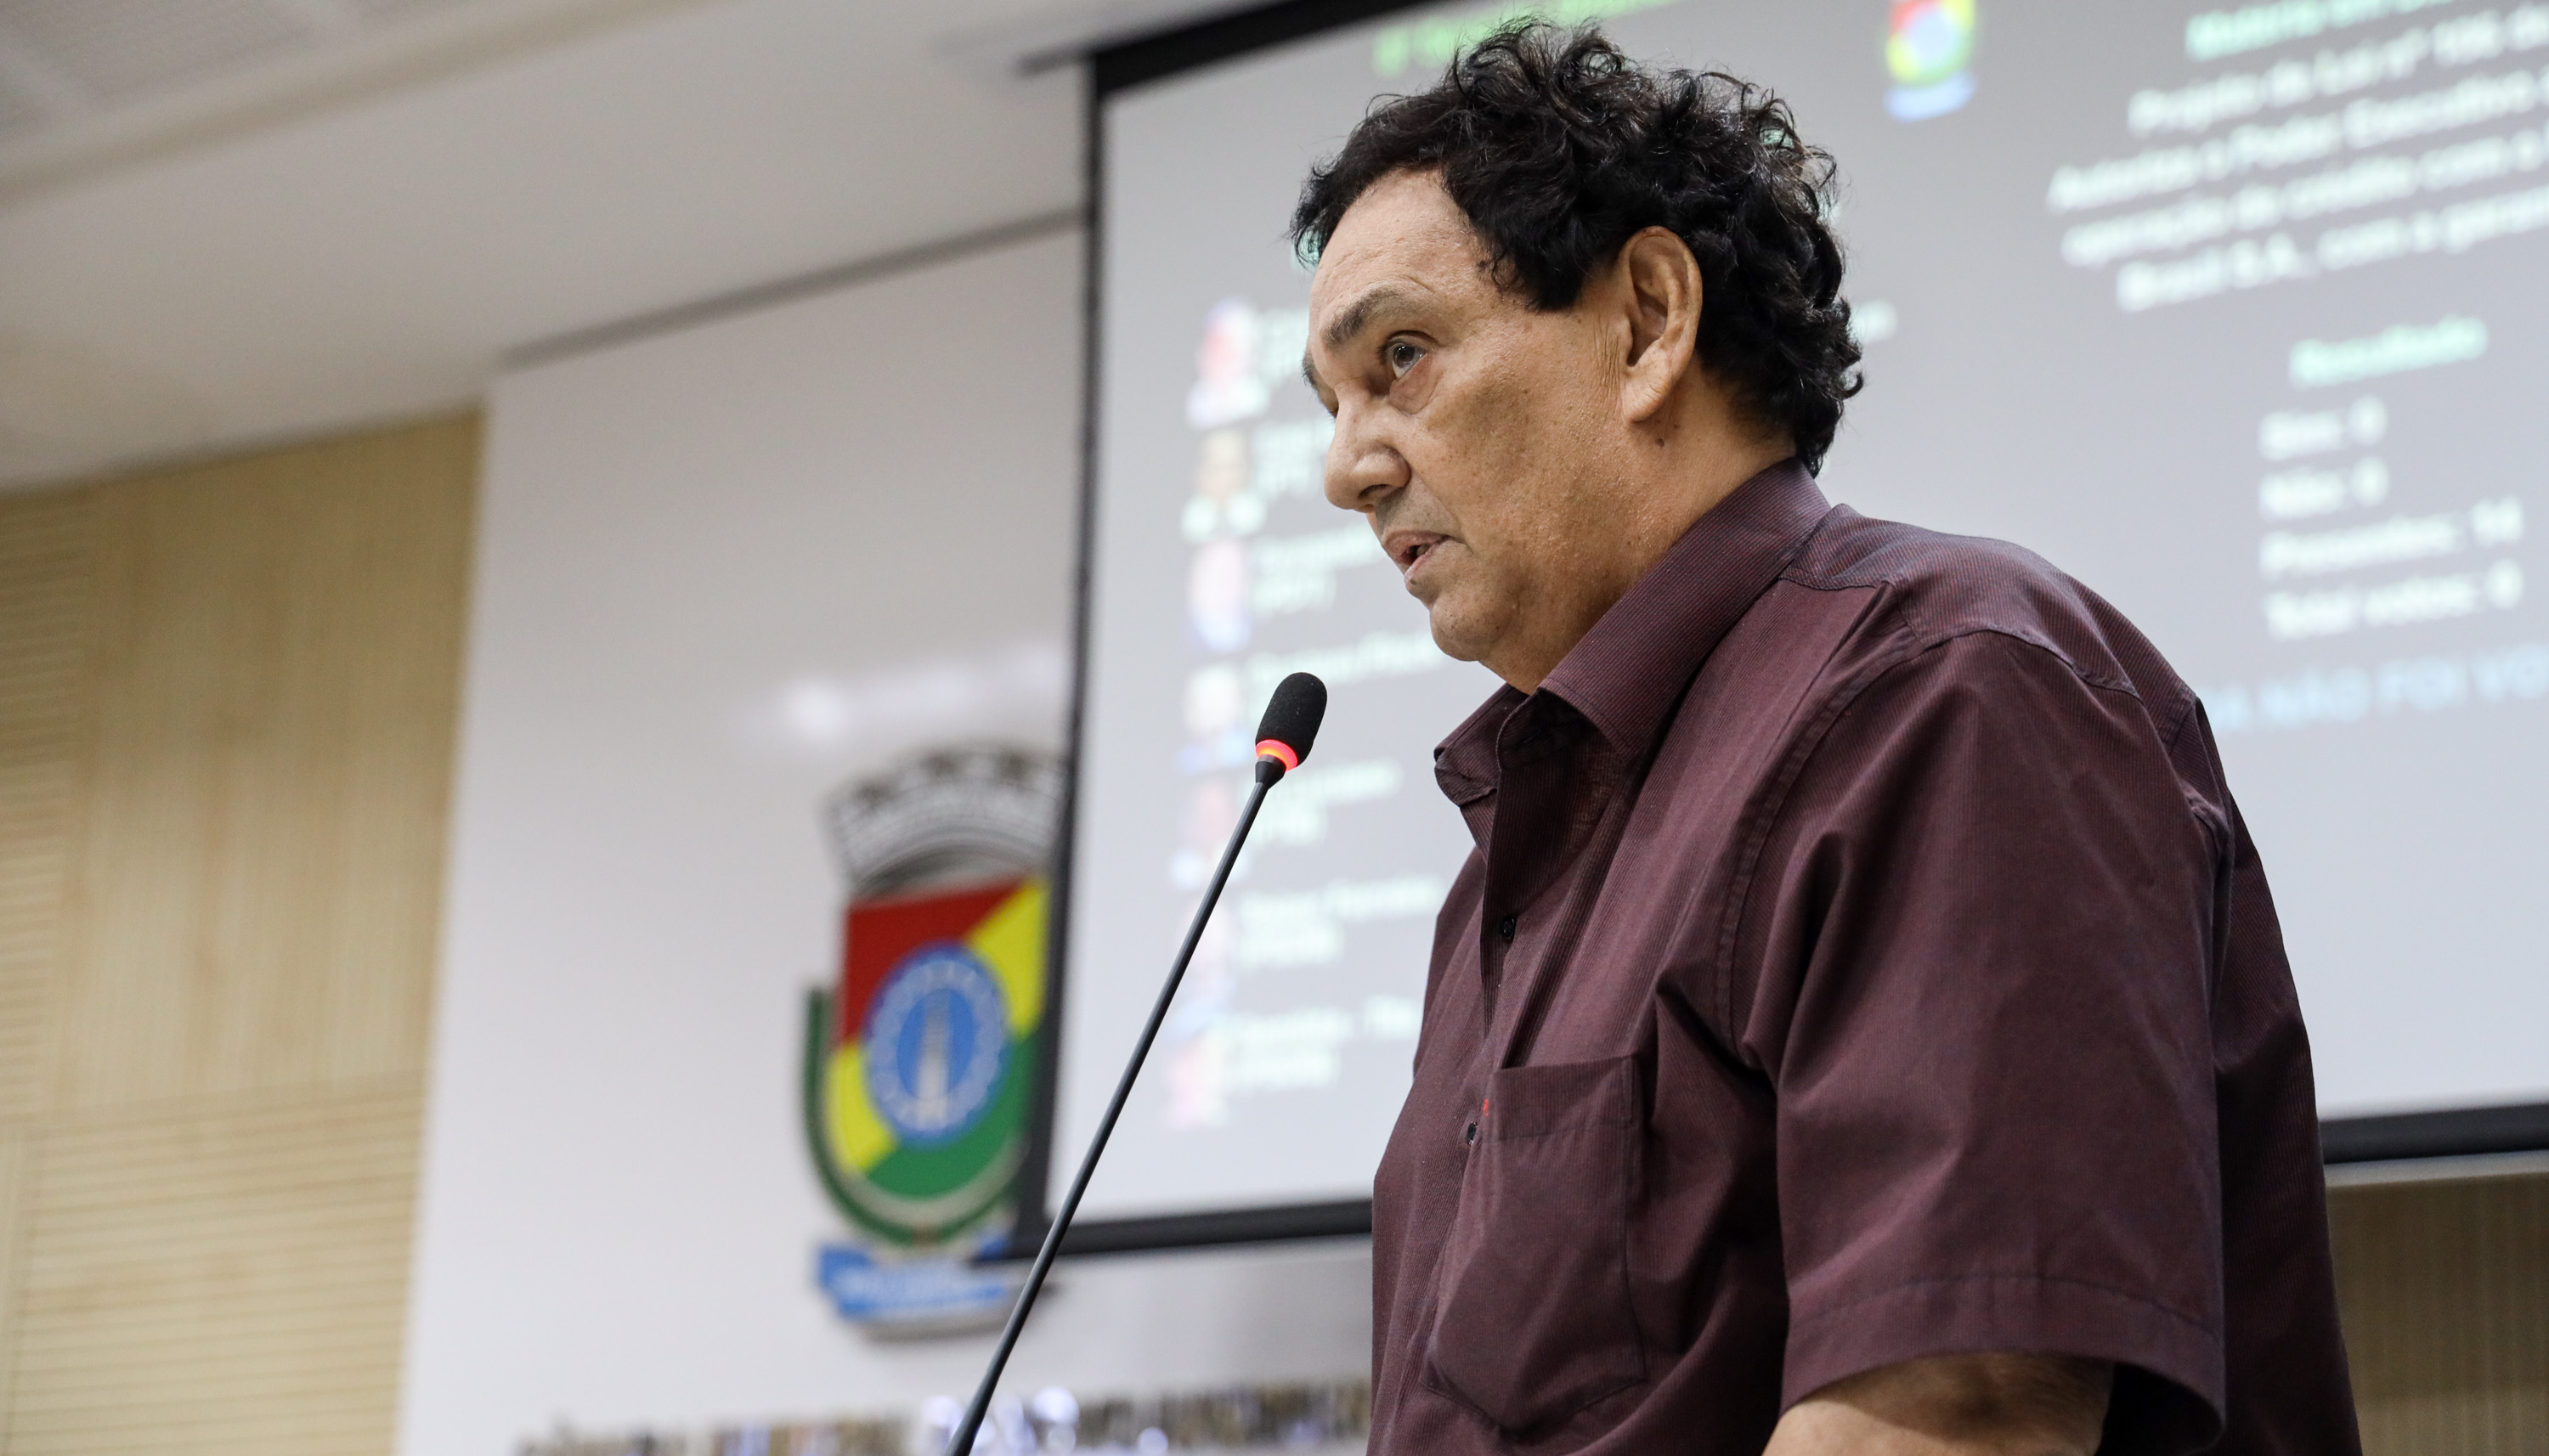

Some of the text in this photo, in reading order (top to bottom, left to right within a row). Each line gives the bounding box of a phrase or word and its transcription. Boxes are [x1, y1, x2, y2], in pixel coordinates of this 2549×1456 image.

[2130, 75, 2261, 138] Projeto
[2048, 148, 2198, 213] Autoriza
[2229, 115, 2341, 169] Poder
[2343, 71, 2535, 148] Executivo
[2118, 250, 2226, 311] Brasil
[2291, 317, 2487, 388] Resultado
[2261, 497, 2522, 578] Presentes: 14
[2267, 588, 2358, 641] Total
[2364, 573, 2482, 625] votos:
[2258, 669, 2369, 728] NÃO
[2377, 658, 2461, 711] FOI
